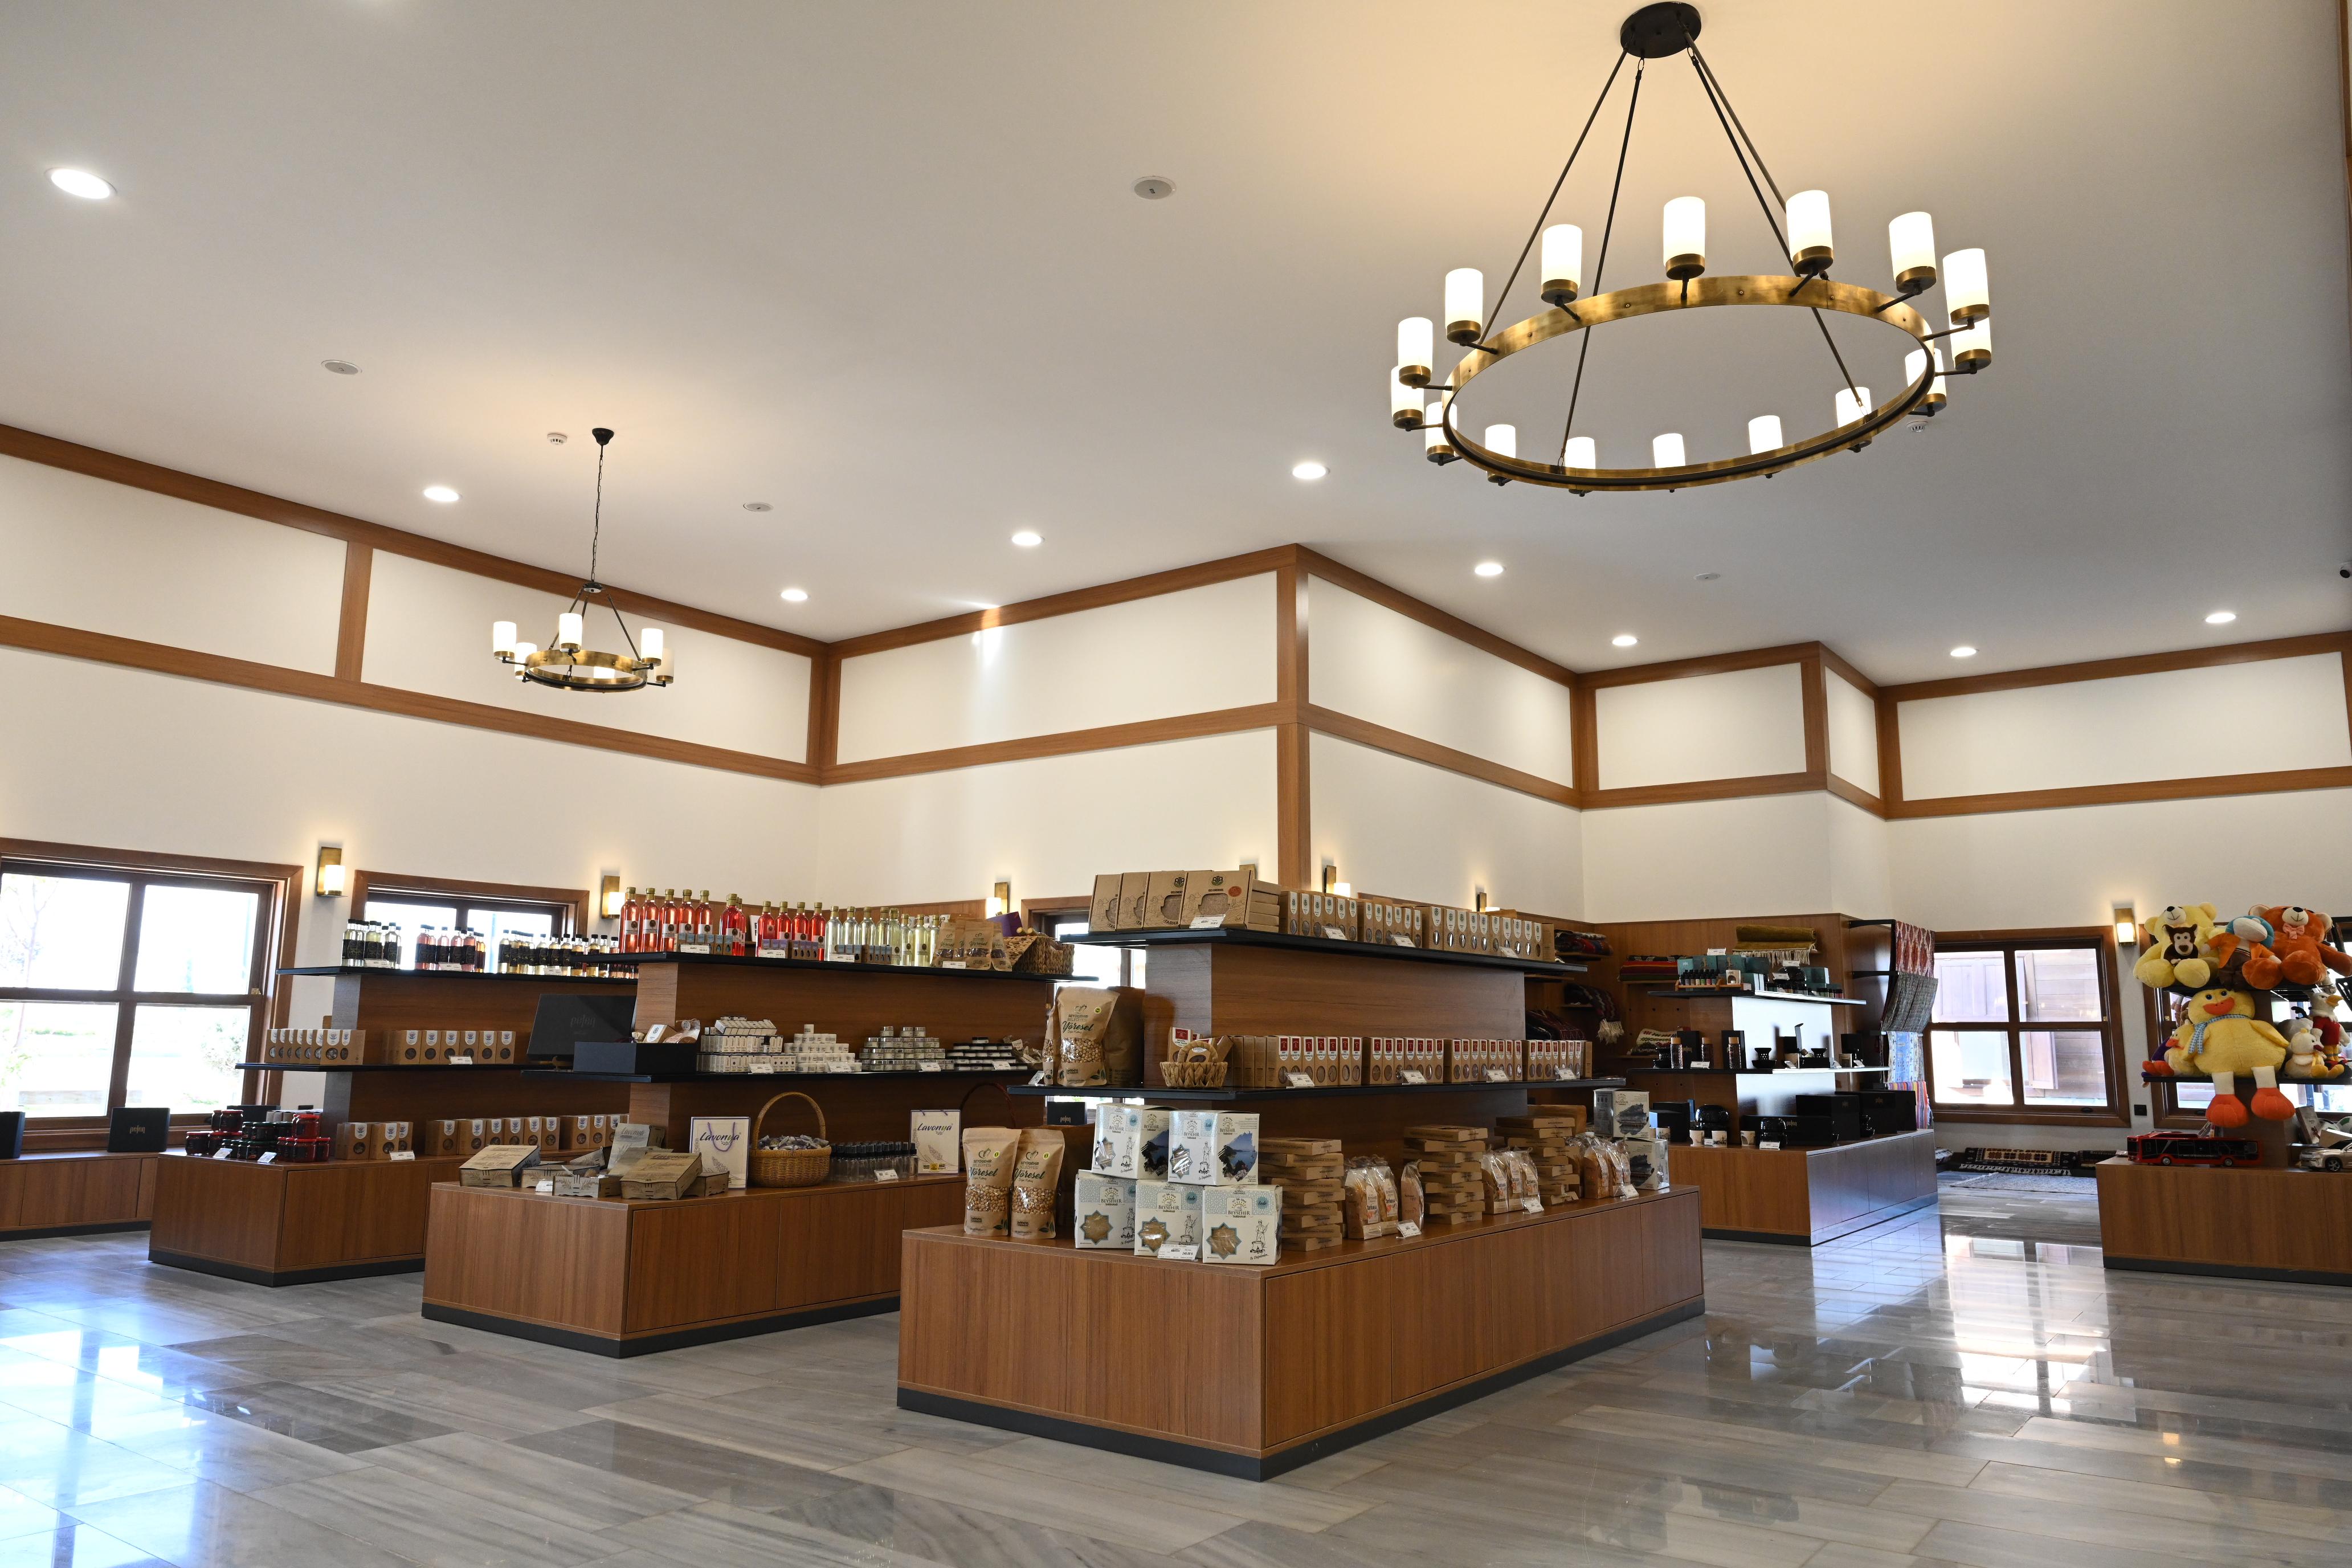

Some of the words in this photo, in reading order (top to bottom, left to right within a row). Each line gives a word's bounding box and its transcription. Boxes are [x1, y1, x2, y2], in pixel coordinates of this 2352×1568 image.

[1062, 1020, 1094, 1034] Yöresel
[918, 1123, 952, 1133] Lavonya
[700, 1132, 740, 1142] Lavonya
[969, 1167, 998, 1181] Yöresel
[1014, 1168, 1046, 1182] Yöresel
